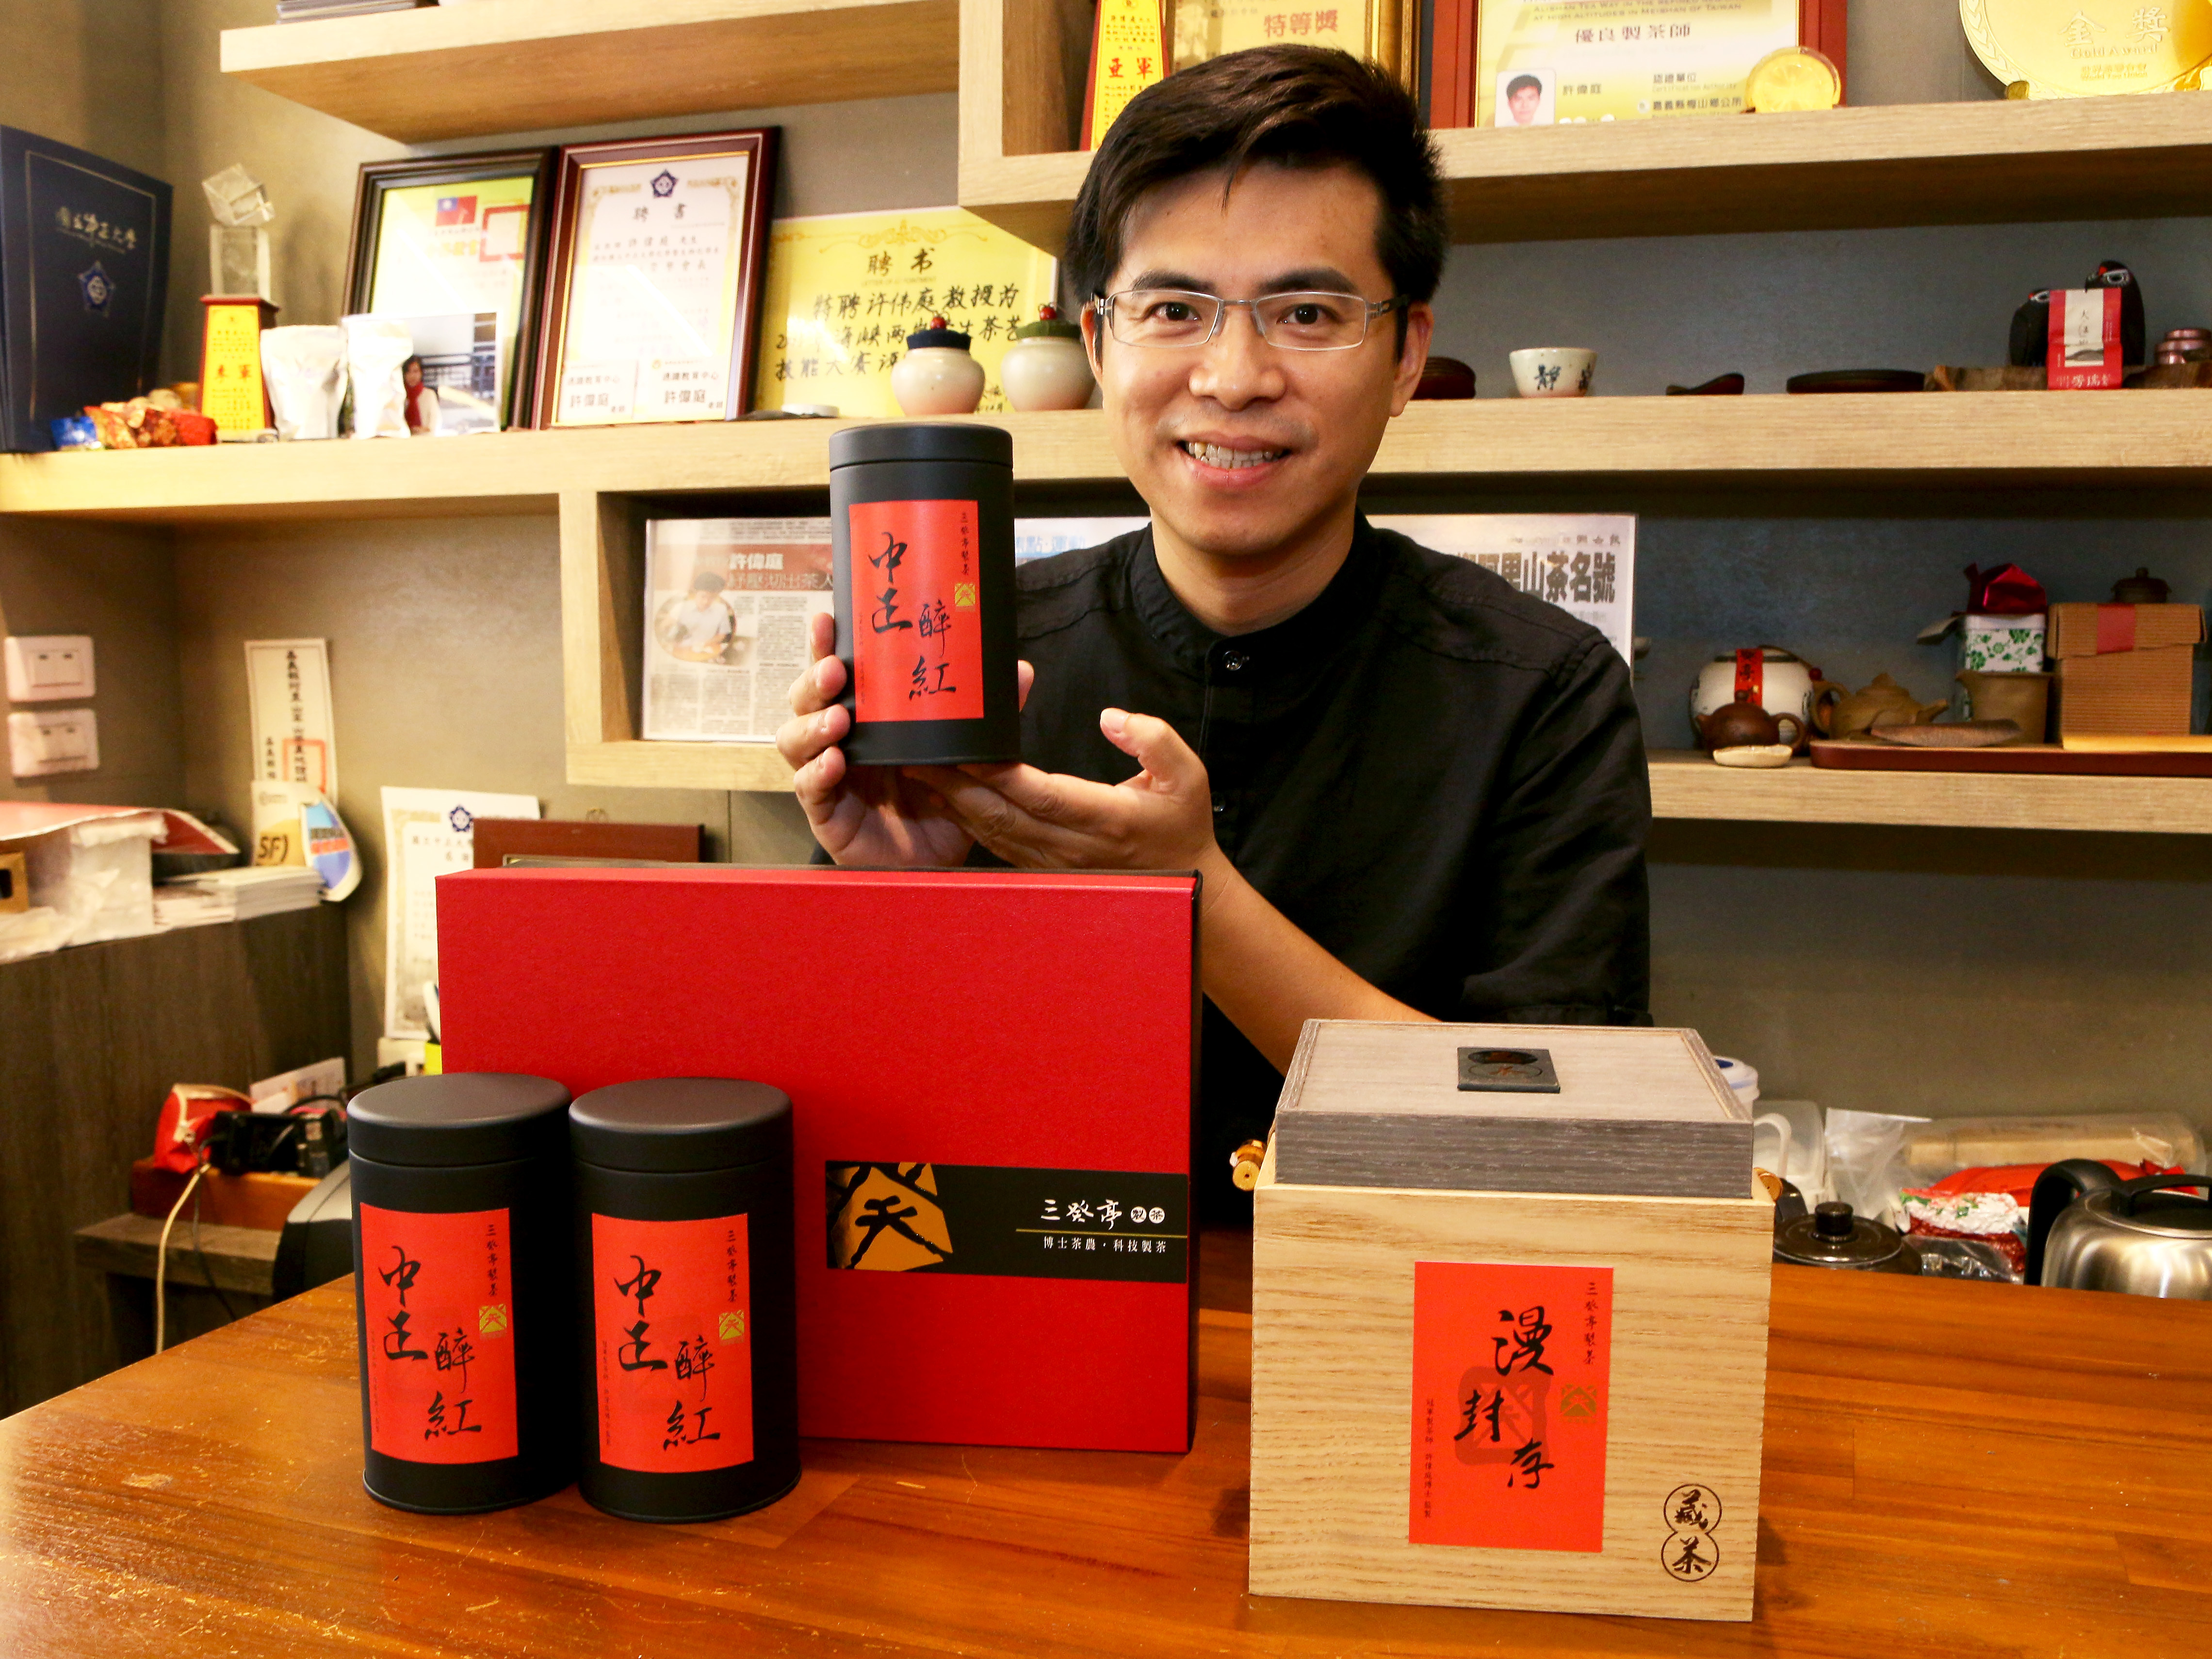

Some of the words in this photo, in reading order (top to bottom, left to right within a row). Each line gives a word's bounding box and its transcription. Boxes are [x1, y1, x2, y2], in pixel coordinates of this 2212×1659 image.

[1264, 10, 1338, 37] 特等獎
[1575, 23, 1692, 43] 優良製茶師
[2058, 7, 2170, 47] 金獎
[2069, 47, 2105, 59] Gold
[2109, 43, 2157, 55] Award
[1109, 57, 1154, 80] 亞軍
[867, 247, 935, 276] 聘书
